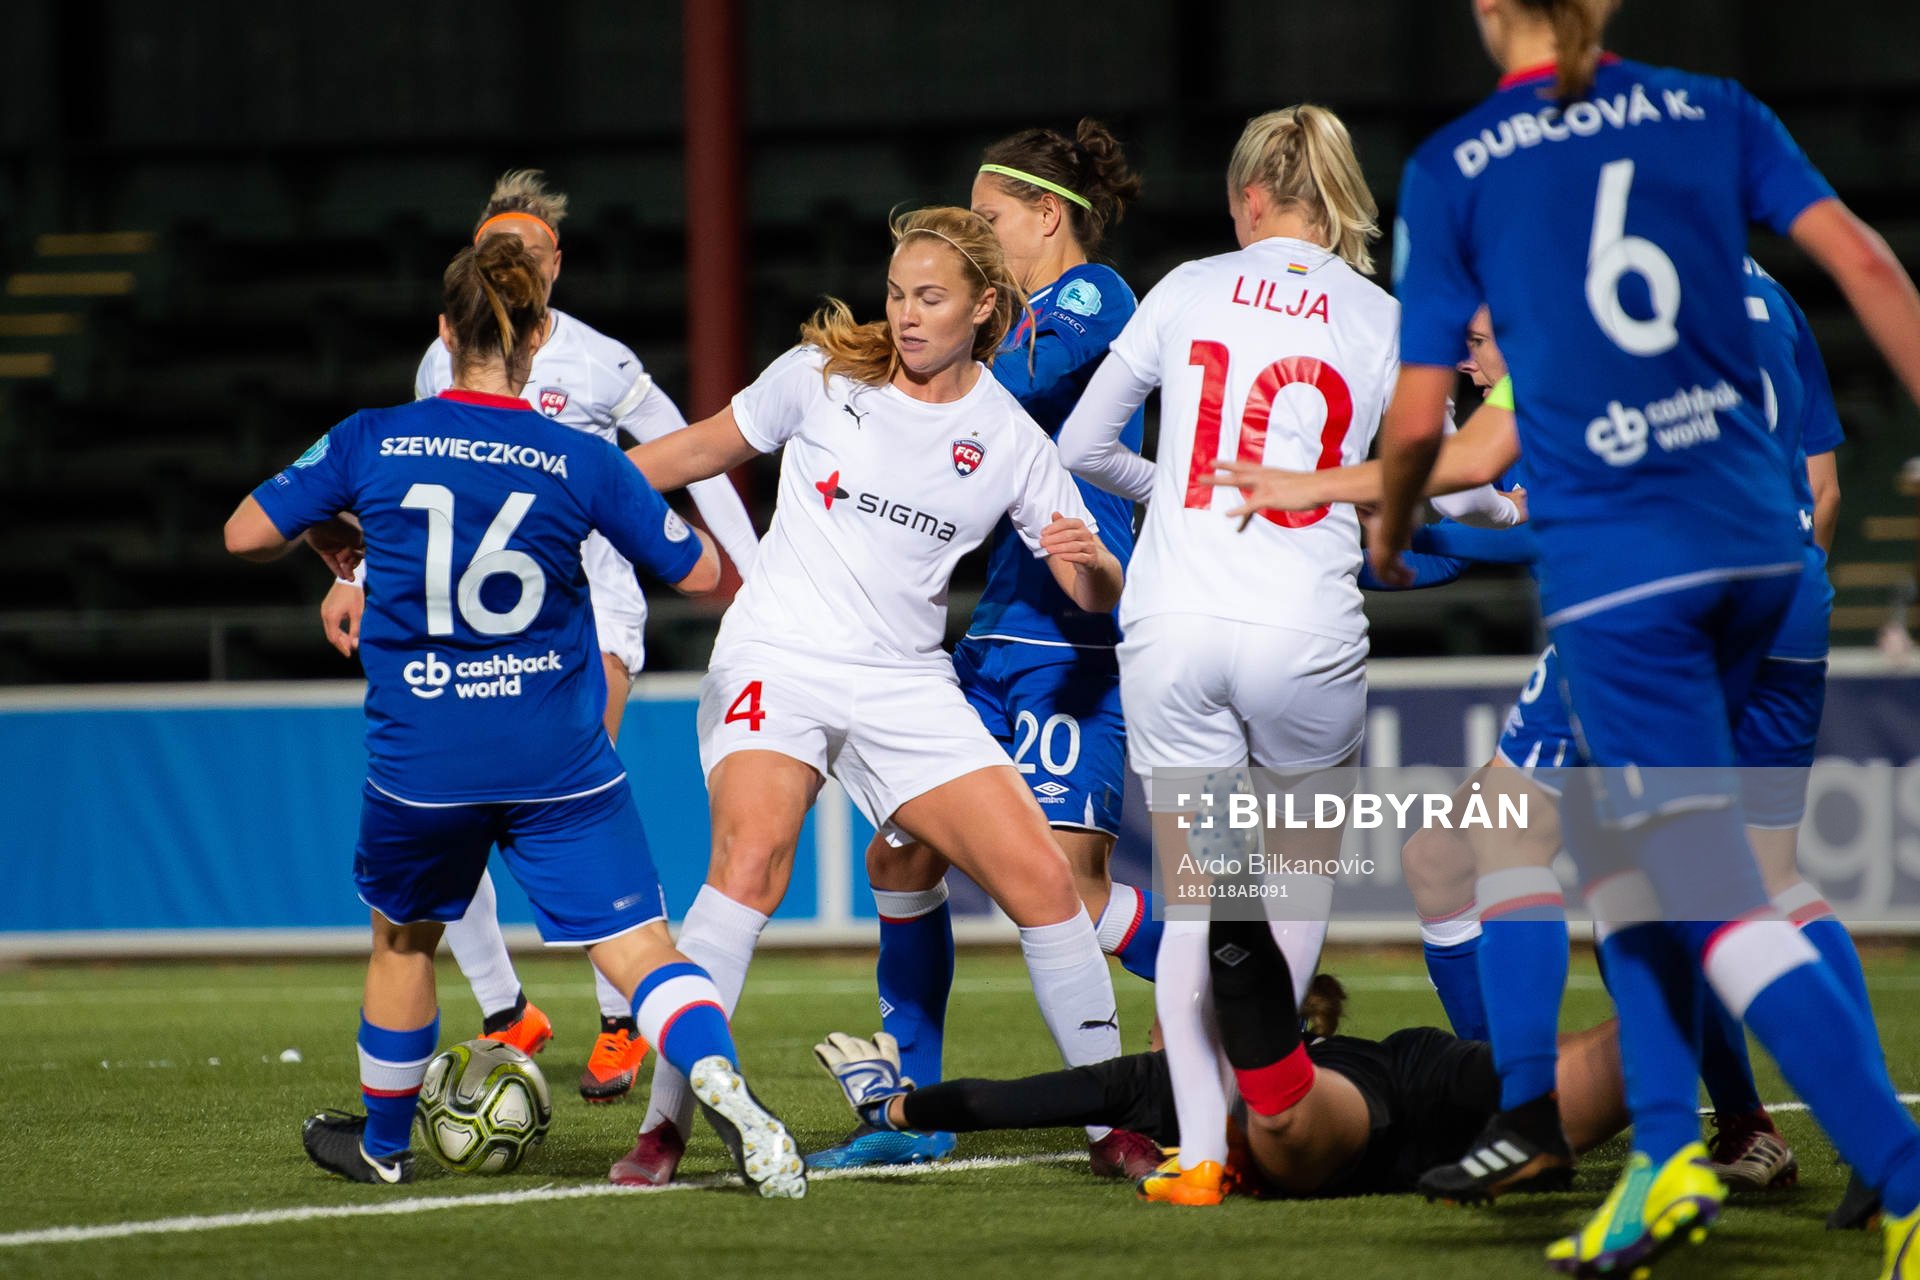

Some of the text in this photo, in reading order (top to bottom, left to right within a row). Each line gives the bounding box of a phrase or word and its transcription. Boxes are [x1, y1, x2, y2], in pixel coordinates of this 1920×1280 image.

[1453, 83, 1706, 179] DUBCOVÁ K.
[1586, 159, 1680, 356] 6
[1231, 275, 1329, 325] LILJA
[379, 435, 568, 480] SZEWIECZKOVÁ
[955, 445, 981, 463] FCR
[1183, 339, 1354, 530] 10
[399, 483, 547, 636] 16
[403, 652, 452, 686] cb
[455, 650, 563, 678] cashback
[455, 675, 522, 699] world
[724, 680, 766, 732] 4
[1014, 709, 1081, 776] 20
